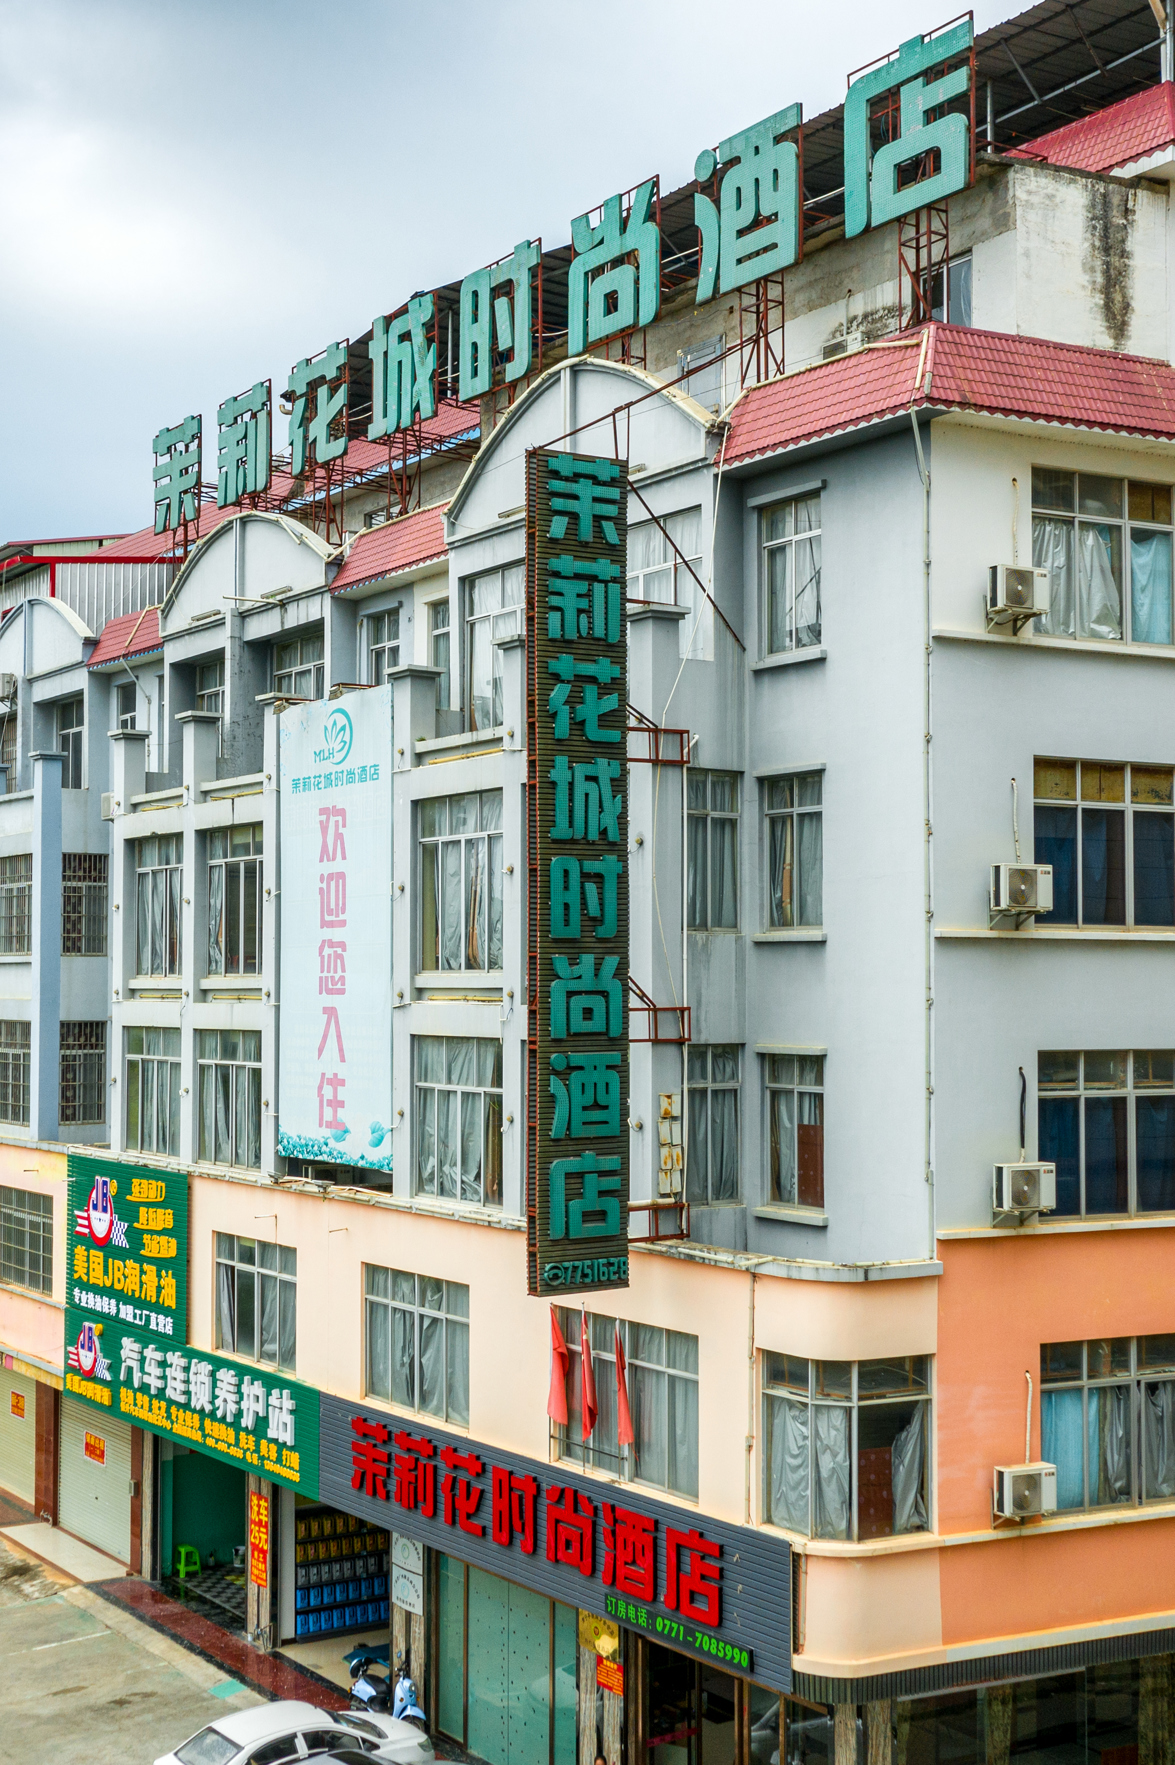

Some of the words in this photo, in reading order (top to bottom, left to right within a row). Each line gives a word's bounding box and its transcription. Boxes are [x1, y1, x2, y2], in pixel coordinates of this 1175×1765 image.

[153, 17, 974, 534] 茉莉花城时尚酒店
[291, 764, 380, 795] 茉莉花城时尚酒店
[313, 746, 335, 764] MLH
[547, 453, 624, 1241] 茉莉花城时尚酒店
[317, 804, 348, 1130] 欢迎您入住
[73, 1245, 176, 1310] 美国JB润滑油
[562, 1256, 628, 1285] 7751628
[73, 1286, 117, 1317] 专业换油保养
[118, 1301, 174, 1336] 加盟工厂直营店
[119, 1336, 295, 1447] 汽车连锁养护站
[250, 1494, 268, 1526] 洗车
[250, 1523, 268, 1551] 25元
[351, 1416, 722, 1627] 茉莉花时尚酒店
[606, 1595, 652, 1629] 订房电话:
[655, 1616, 749, 1668] 0771-7085990
